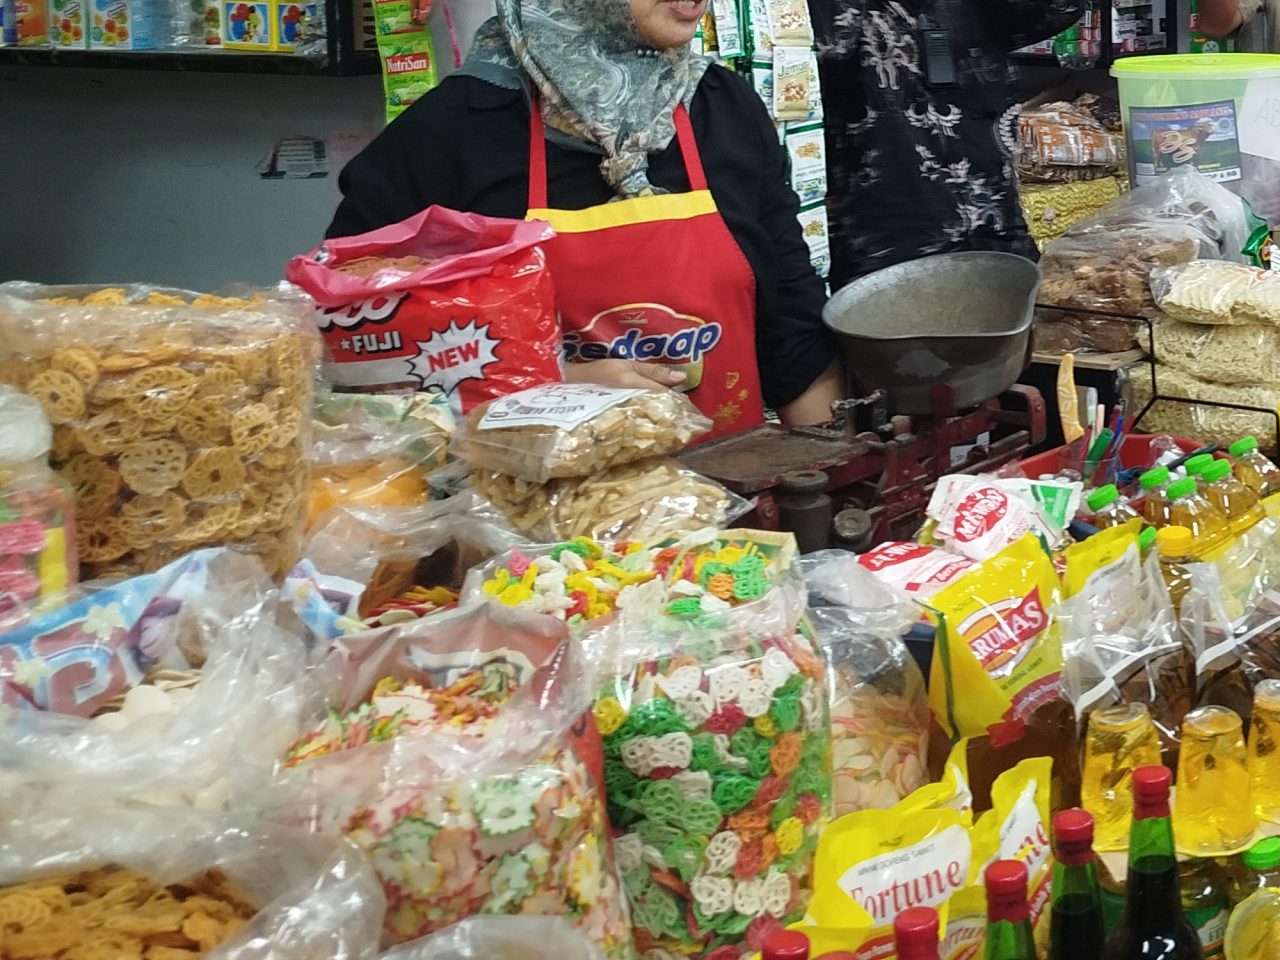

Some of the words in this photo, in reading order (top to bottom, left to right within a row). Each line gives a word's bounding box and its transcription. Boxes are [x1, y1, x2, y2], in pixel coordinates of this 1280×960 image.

[387, 56, 427, 74] NutriSari
[353, 331, 401, 354] FUJI
[426, 340, 481, 373] NEW
[562, 323, 721, 363] Sedaap
[850, 860, 961, 920] Fortune
